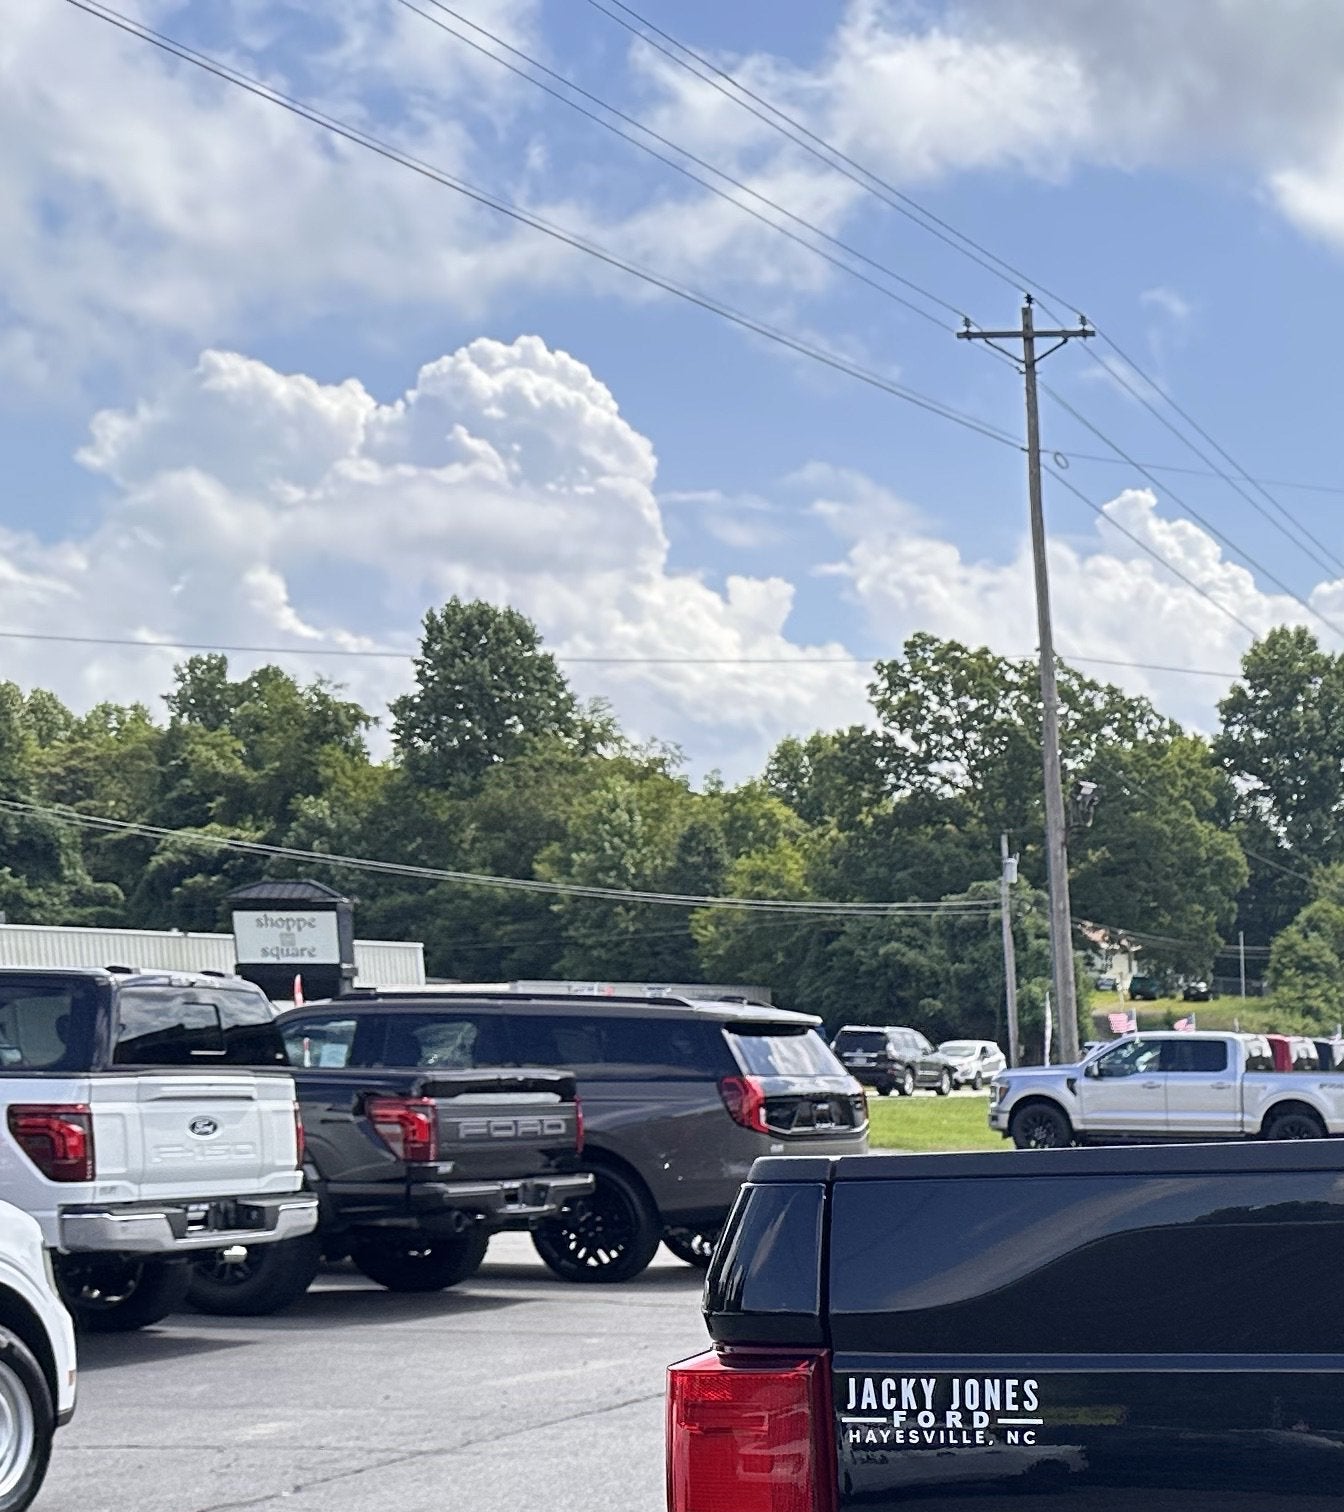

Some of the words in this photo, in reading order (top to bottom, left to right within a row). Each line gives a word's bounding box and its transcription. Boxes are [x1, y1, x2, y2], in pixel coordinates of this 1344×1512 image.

[256, 913, 316, 931] shoppe
[261, 945, 316, 960] square
[459, 1118, 566, 1139] FORD
[847, 1378, 937, 1410] JACKY
[950, 1378, 1039, 1411] JONES
[893, 1410, 990, 1428] FORD
[849, 1429, 994, 1446] HAYESVILLE,
[1006, 1430, 1036, 1445] NC
